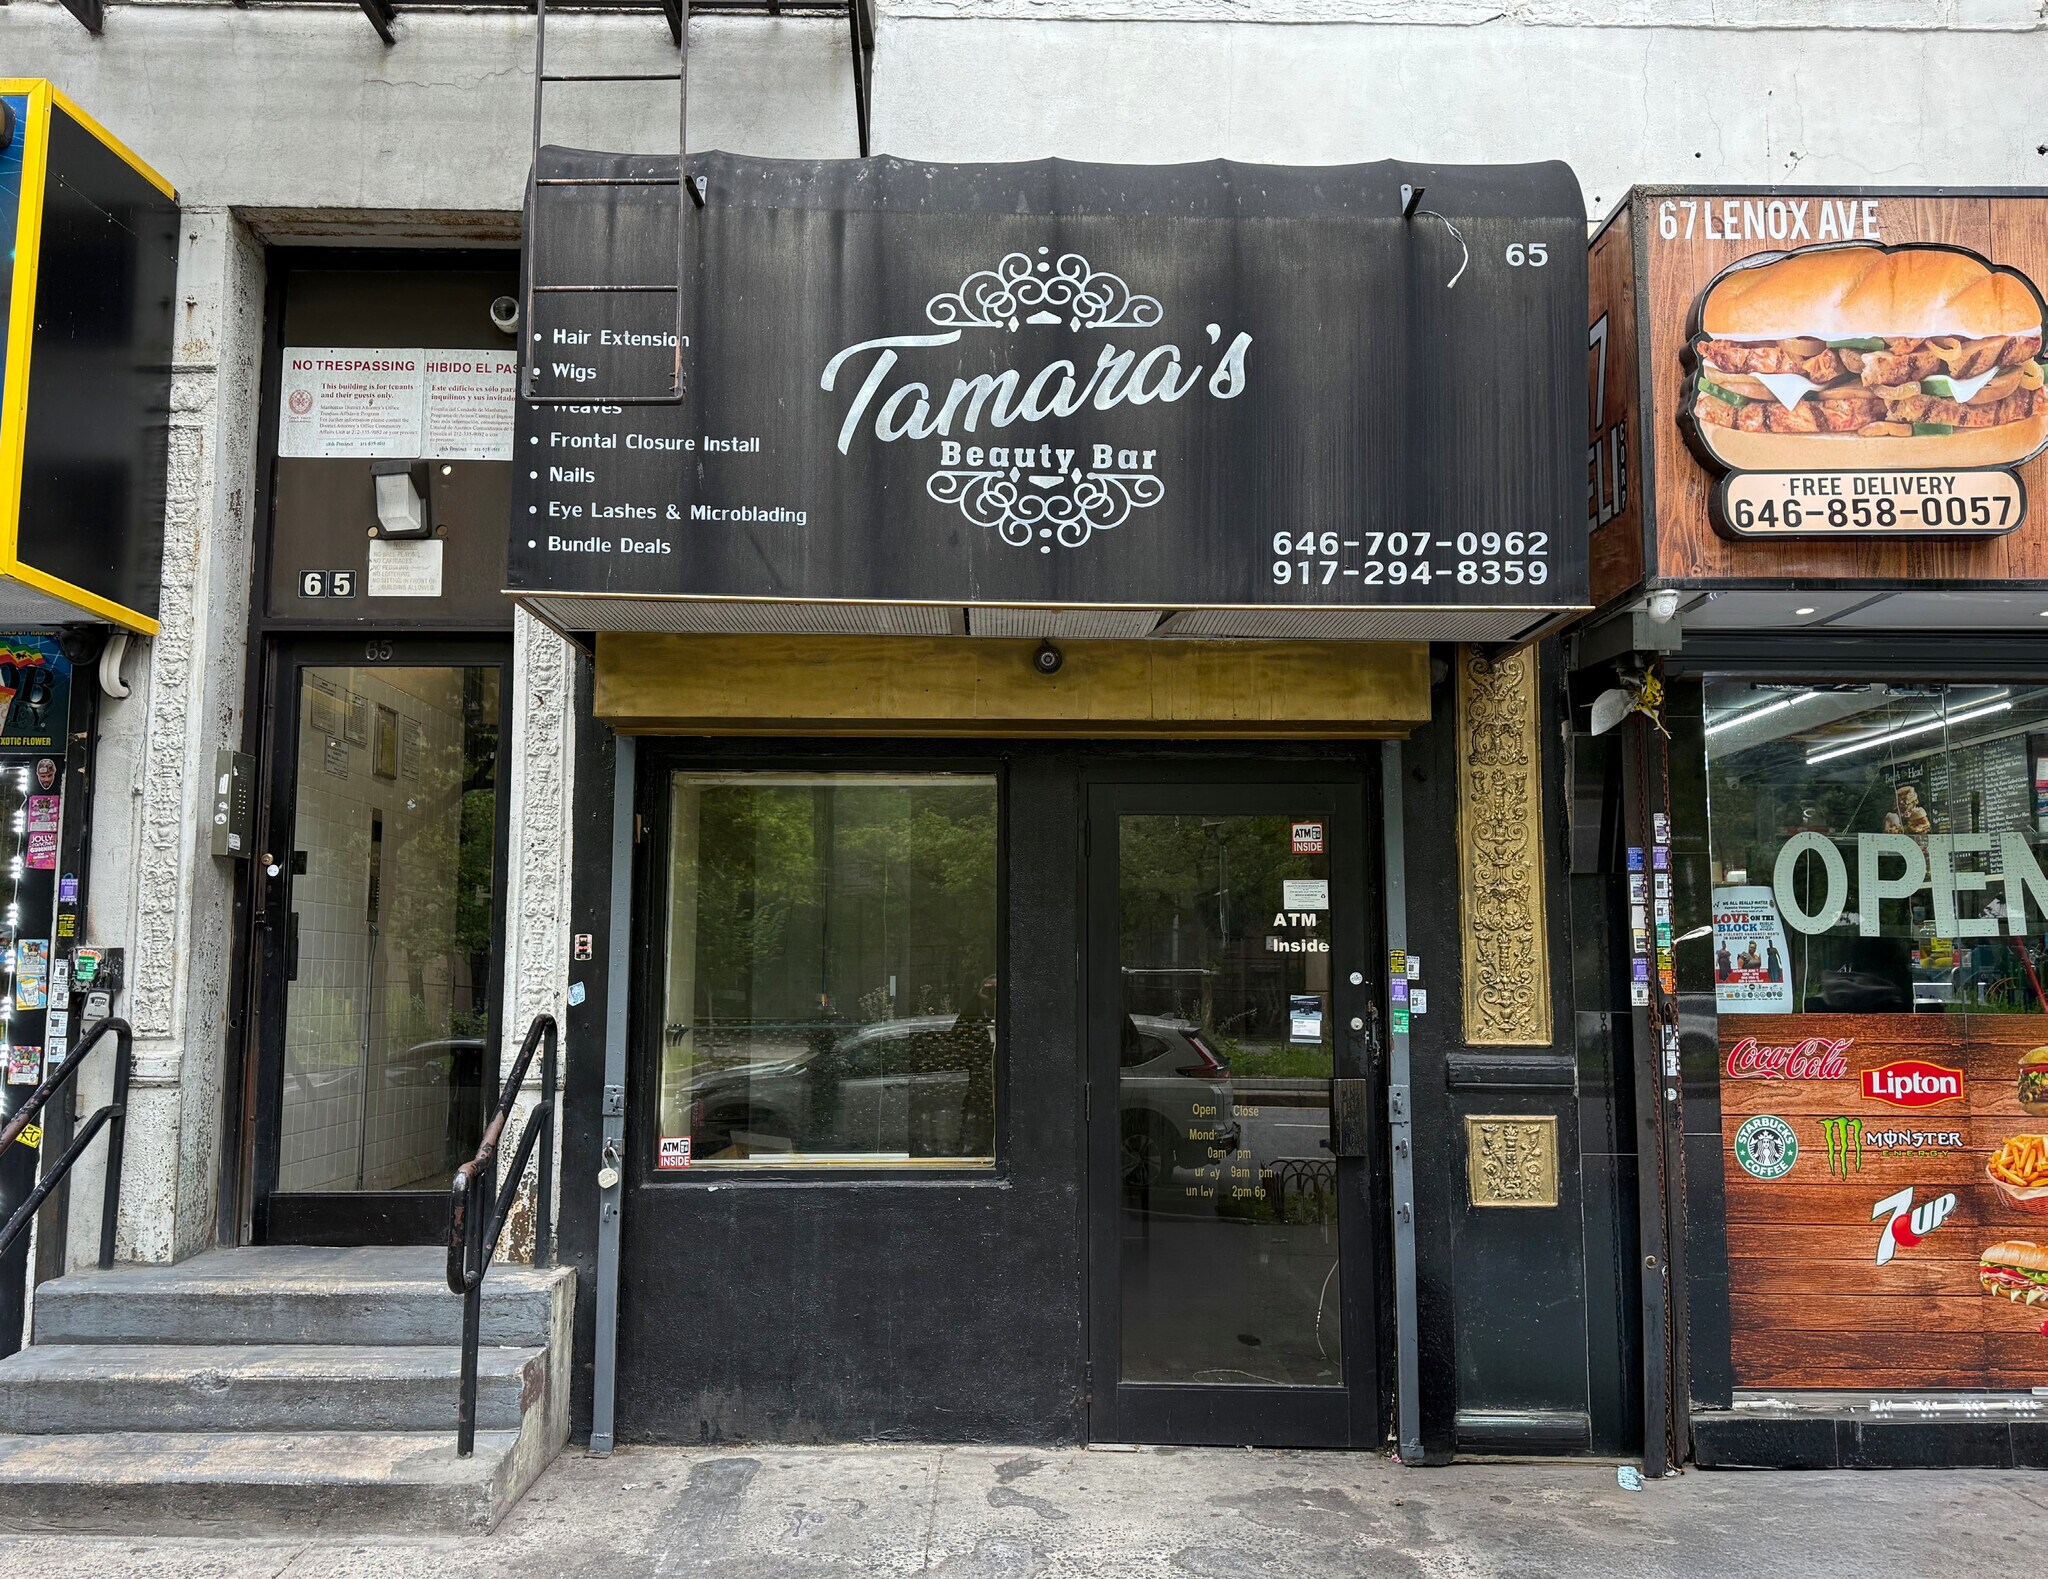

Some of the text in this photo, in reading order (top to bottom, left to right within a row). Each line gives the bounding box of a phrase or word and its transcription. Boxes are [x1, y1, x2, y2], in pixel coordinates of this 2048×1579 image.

[1659, 200, 1881, 240] 67 LENOX AVE
[1505, 243, 1549, 267] 65
[552, 329, 690, 347] Hair Extension
[292, 360, 415, 372] NO TRESPASSING
[426, 362, 472, 373] HIBIDO
[475, 363, 492, 373] EL
[552, 363, 597, 382] Wigs
[338, 383, 367, 391] building
[431, 384, 447, 392] Este
[448, 384, 474, 392] edificio
[820, 323, 1253, 456] Tamara's
[377, 392, 394, 400] only.
[431, 393, 466, 401] inquilinos
[550, 432, 760, 452] Frontal Closure Install
[940, 440, 1157, 474] Beauty Bar
[549, 467, 596, 484] Nails
[1789, 476, 1957, 496] FREE DELIVERY
[548, 502, 807, 525] Eye Lashes & Microblading
[1734, 497, 2012, 528] 646-858-0057
[547, 536, 671, 554] Bundle Deals
[1272, 531, 1549, 556] 646-707-0962
[1272, 560, 1549, 585] 917-294-8359
[304, 573, 351, 596] 65
[366, 640, 393, 661] 65
[23, 737, 52, 746] FLOWER
[31, 834, 53, 843] JOLLY
[1294, 829, 1311, 839] ATM
[1293, 841, 1323, 852] INSIDE
[1273, 912, 1317, 927] ATM
[1713, 913, 1749, 924] LOVE
[1718, 923, 1757, 932] BLOCK
[1273, 938, 1330, 952] Inside
[1871, 1070, 1957, 1098] Lipton
[1192, 1103, 1260, 1117] Open Close
[1738, 1116, 1795, 1145] STARBUCKS
[1865, 1129, 1964, 1149] MONSTER
[662, 1142, 679, 1153] ATM
[1881, 1150, 1950, 1158] ENERGY
[660, 1157, 690, 1167] INSIDE
[1745, 1159, 1789, 1177] COFFEE
[1231, 1166, 1250, 1178] 9am
